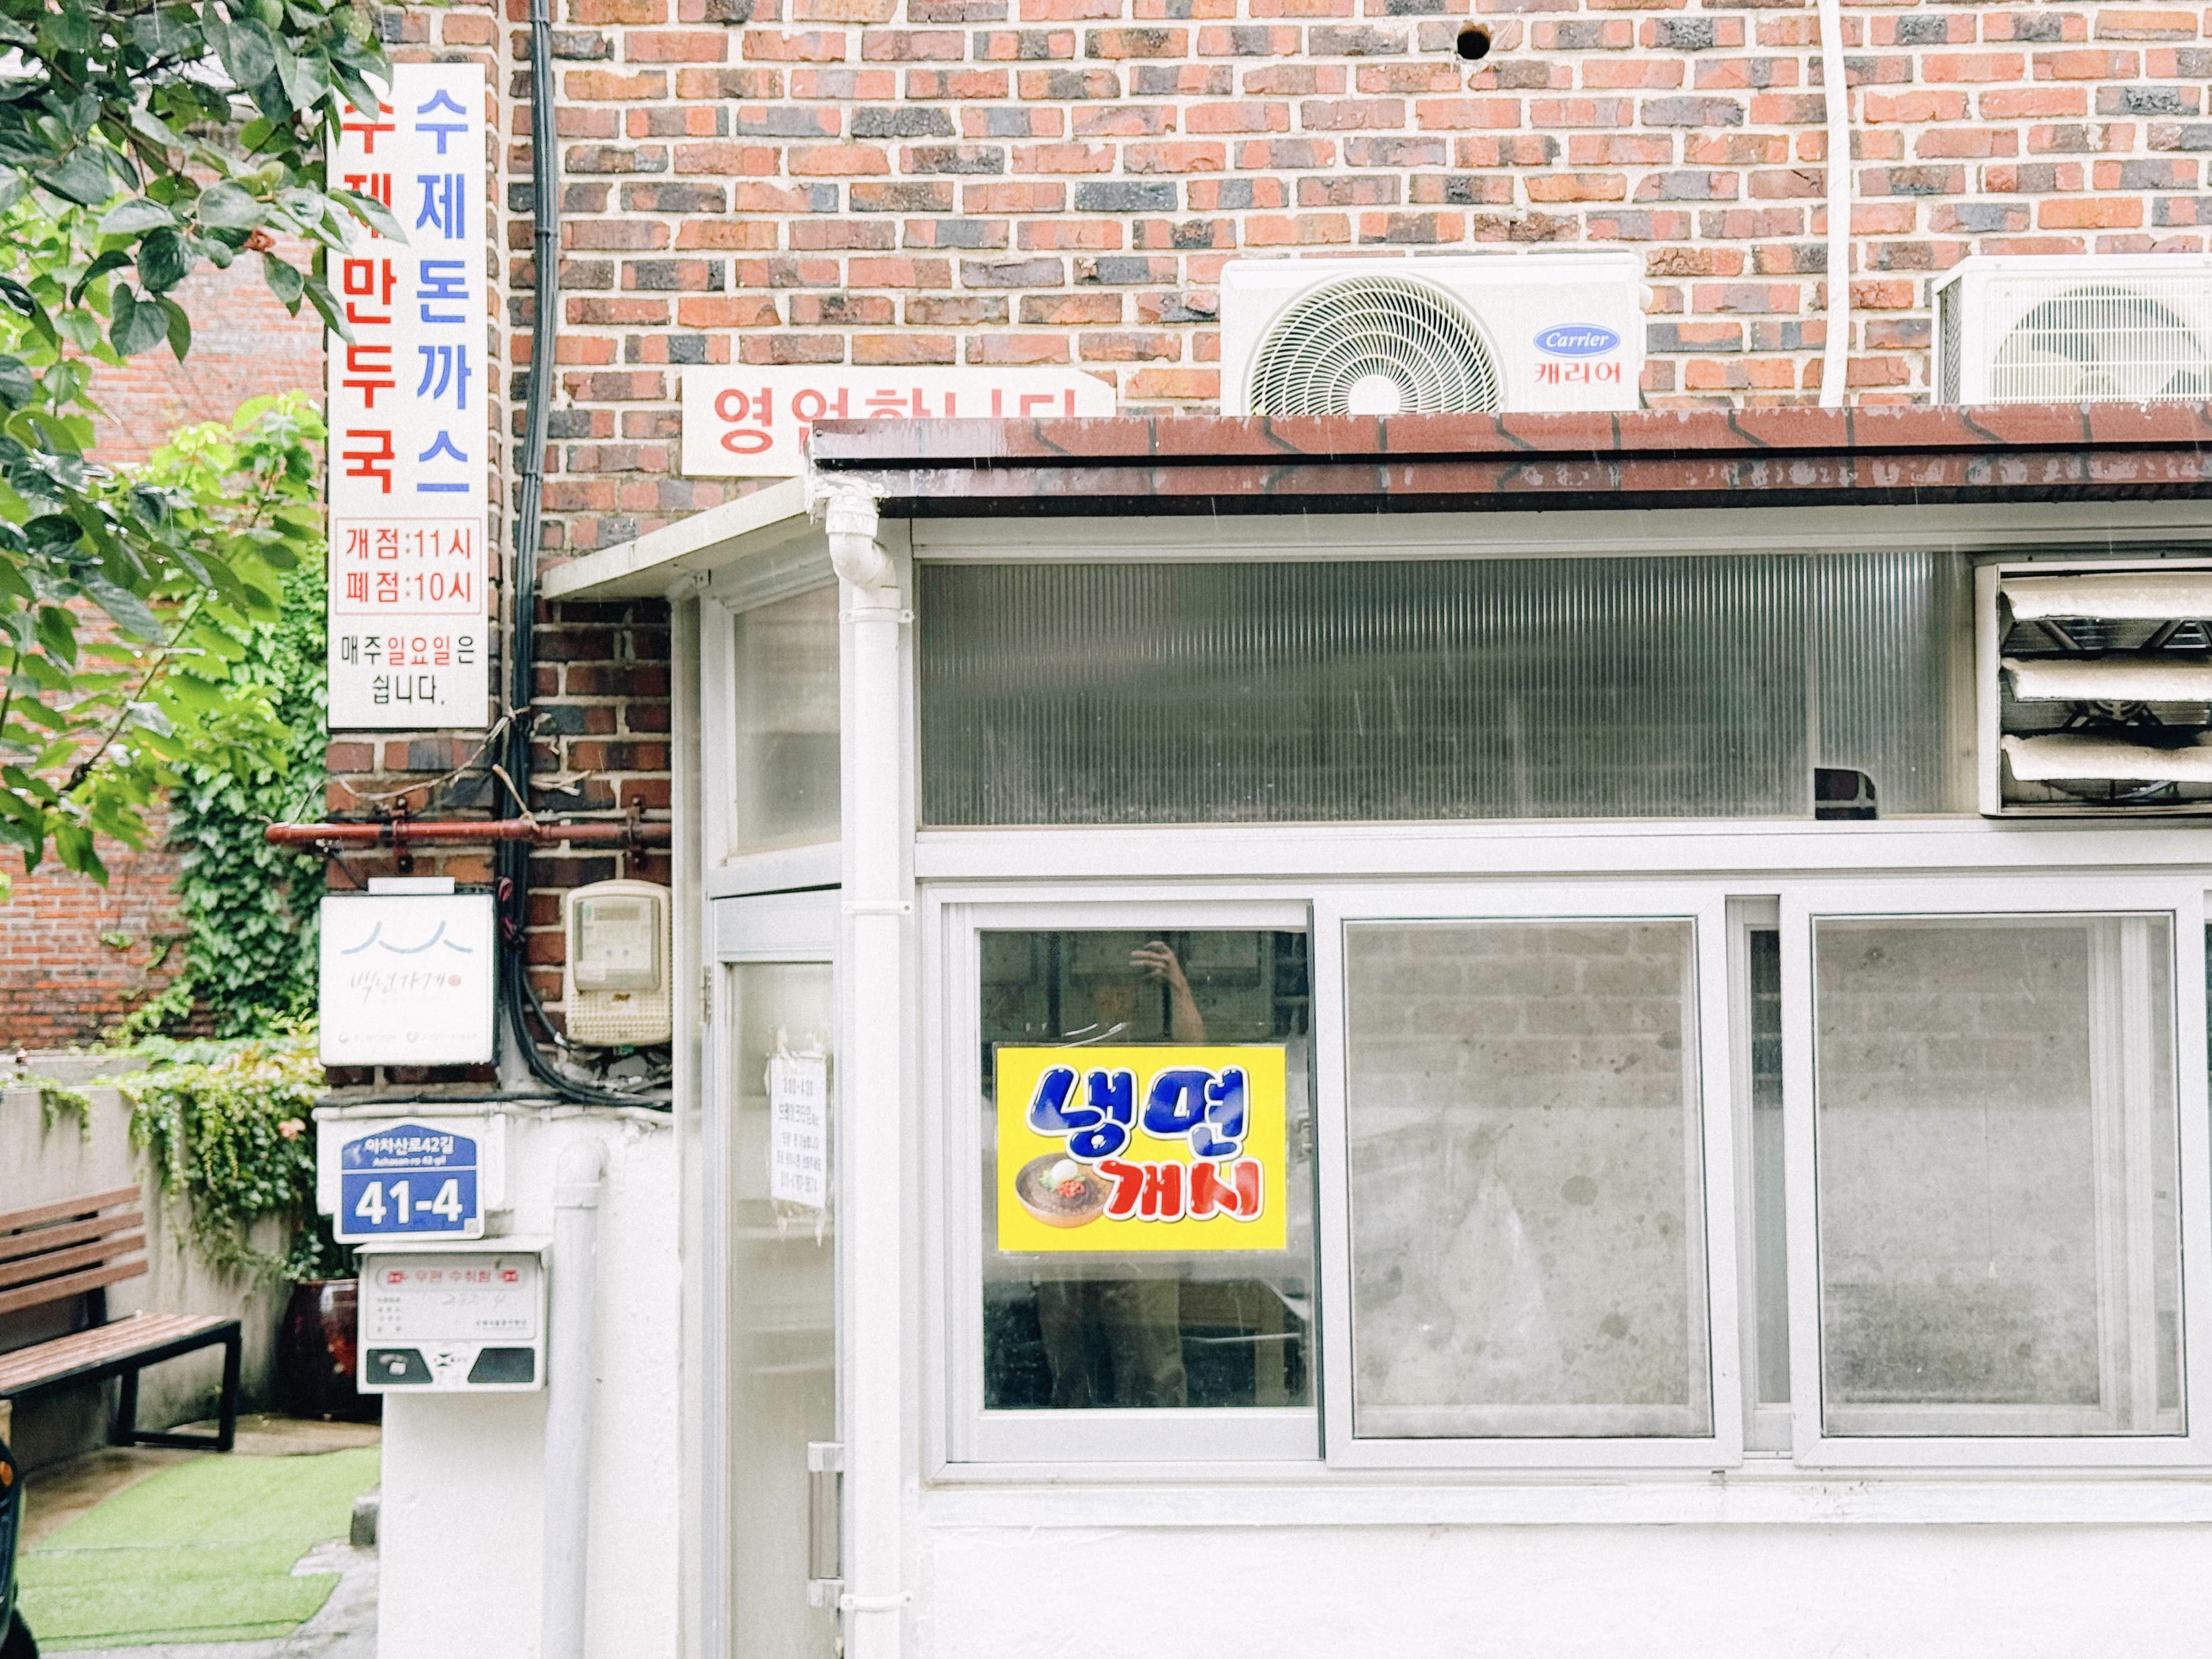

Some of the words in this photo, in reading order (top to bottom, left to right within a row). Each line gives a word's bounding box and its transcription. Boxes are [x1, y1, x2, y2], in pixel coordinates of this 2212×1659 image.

[415, 89, 472, 492] 수제돈까스
[1546, 331, 1609, 348] Carrier
[1533, 361, 1621, 384] 캐리어
[346, 528, 470, 560] 개점:11시
[346, 571, 470, 603] 폐점:10시
[373, 675, 444, 705] 쉽니다.
[1029, 1067, 1246, 1159] 냉면
[355, 1179, 463, 1225] 41-4
[1097, 1159, 1260, 1217] 개시
